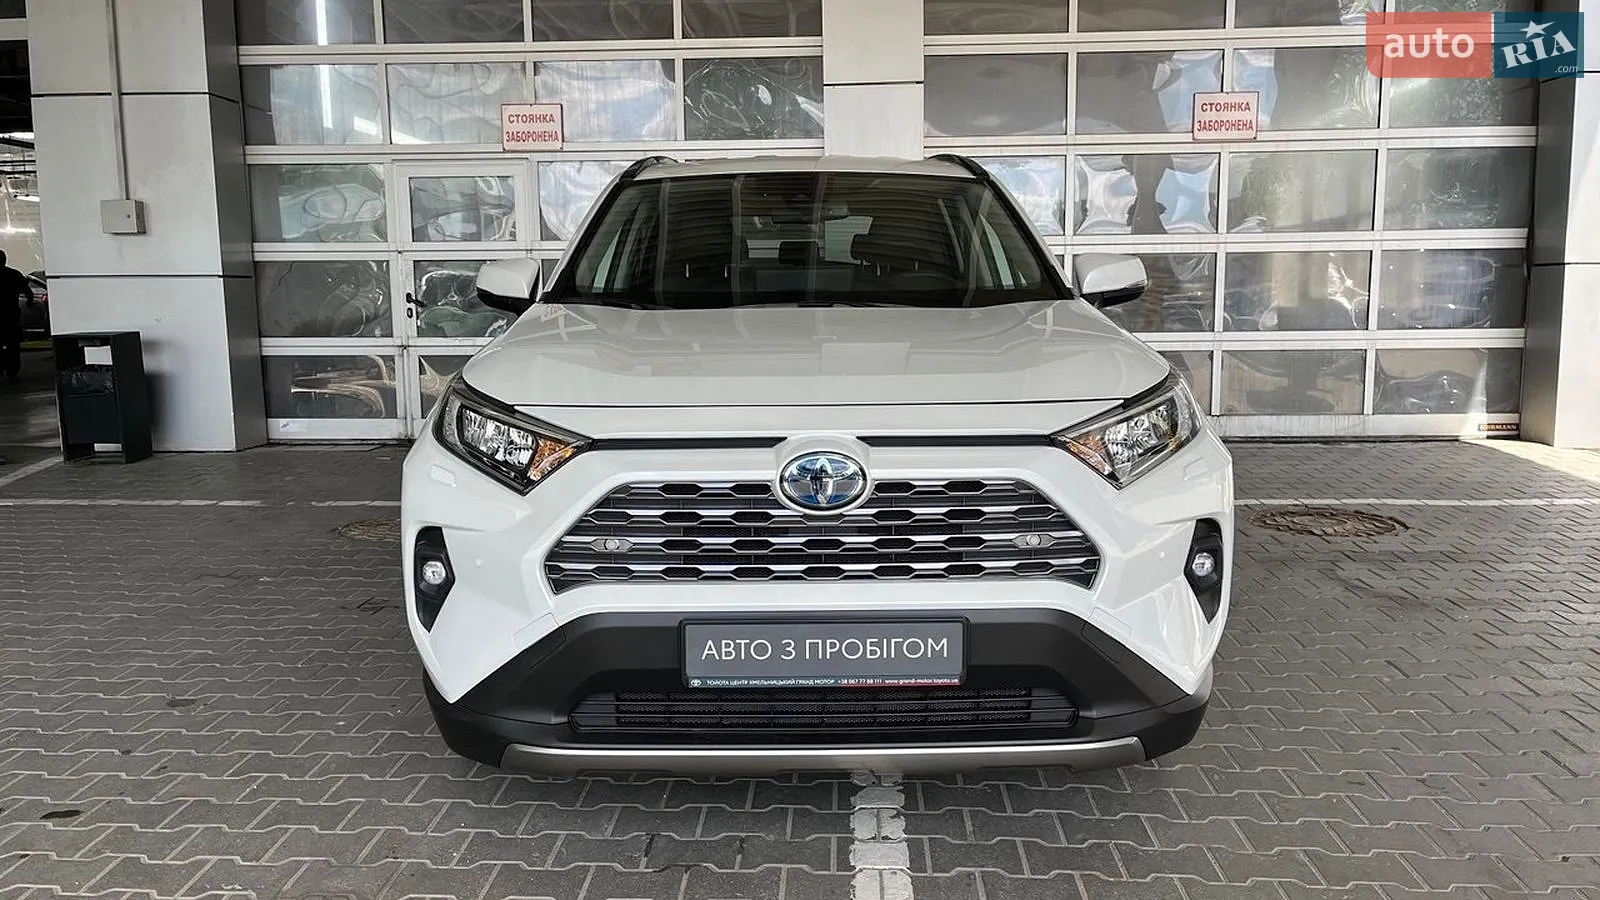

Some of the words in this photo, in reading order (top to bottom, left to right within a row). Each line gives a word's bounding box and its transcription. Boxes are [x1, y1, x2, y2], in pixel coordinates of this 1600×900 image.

[1200, 102, 1251, 113] СТОЯНКА
[508, 113, 556, 124] СТОЯНКА
[1196, 119, 1254, 132] ЗАБОРОНЕНА
[505, 130, 560, 143] ЗАБОРОНЕНА
[701, 639, 772, 660] АВТО
[805, 637, 948, 660] ПРОБІГОМ
